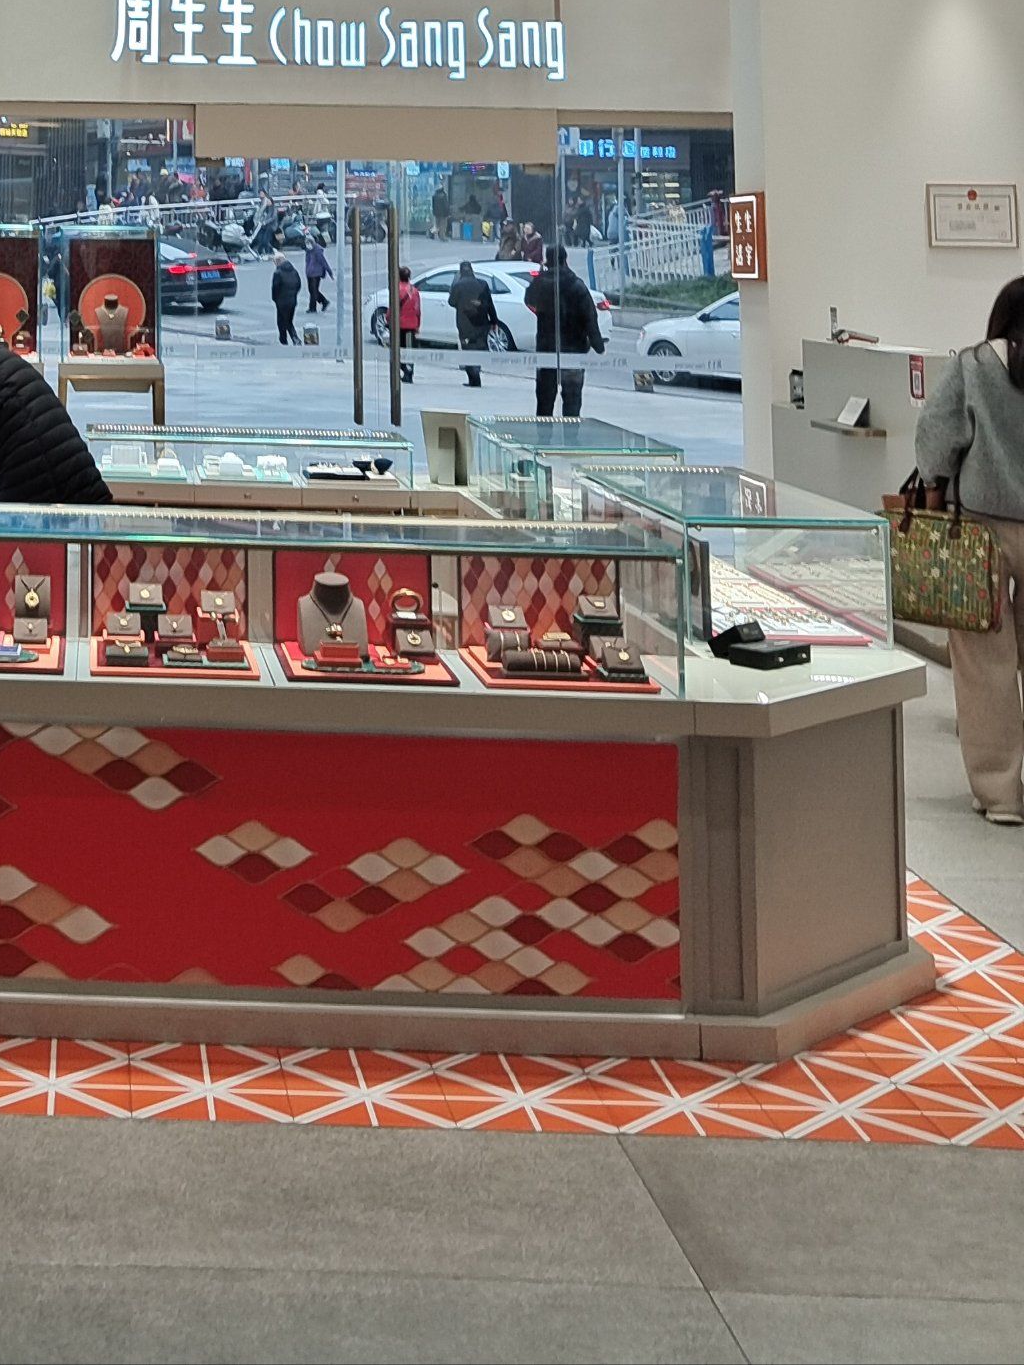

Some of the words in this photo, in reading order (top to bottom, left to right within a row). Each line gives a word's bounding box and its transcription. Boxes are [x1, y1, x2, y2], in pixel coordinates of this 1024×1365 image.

[270, 6, 366, 67] Chow
[379, 6, 466, 80] Sang
[477, 6, 566, 81] Sang
